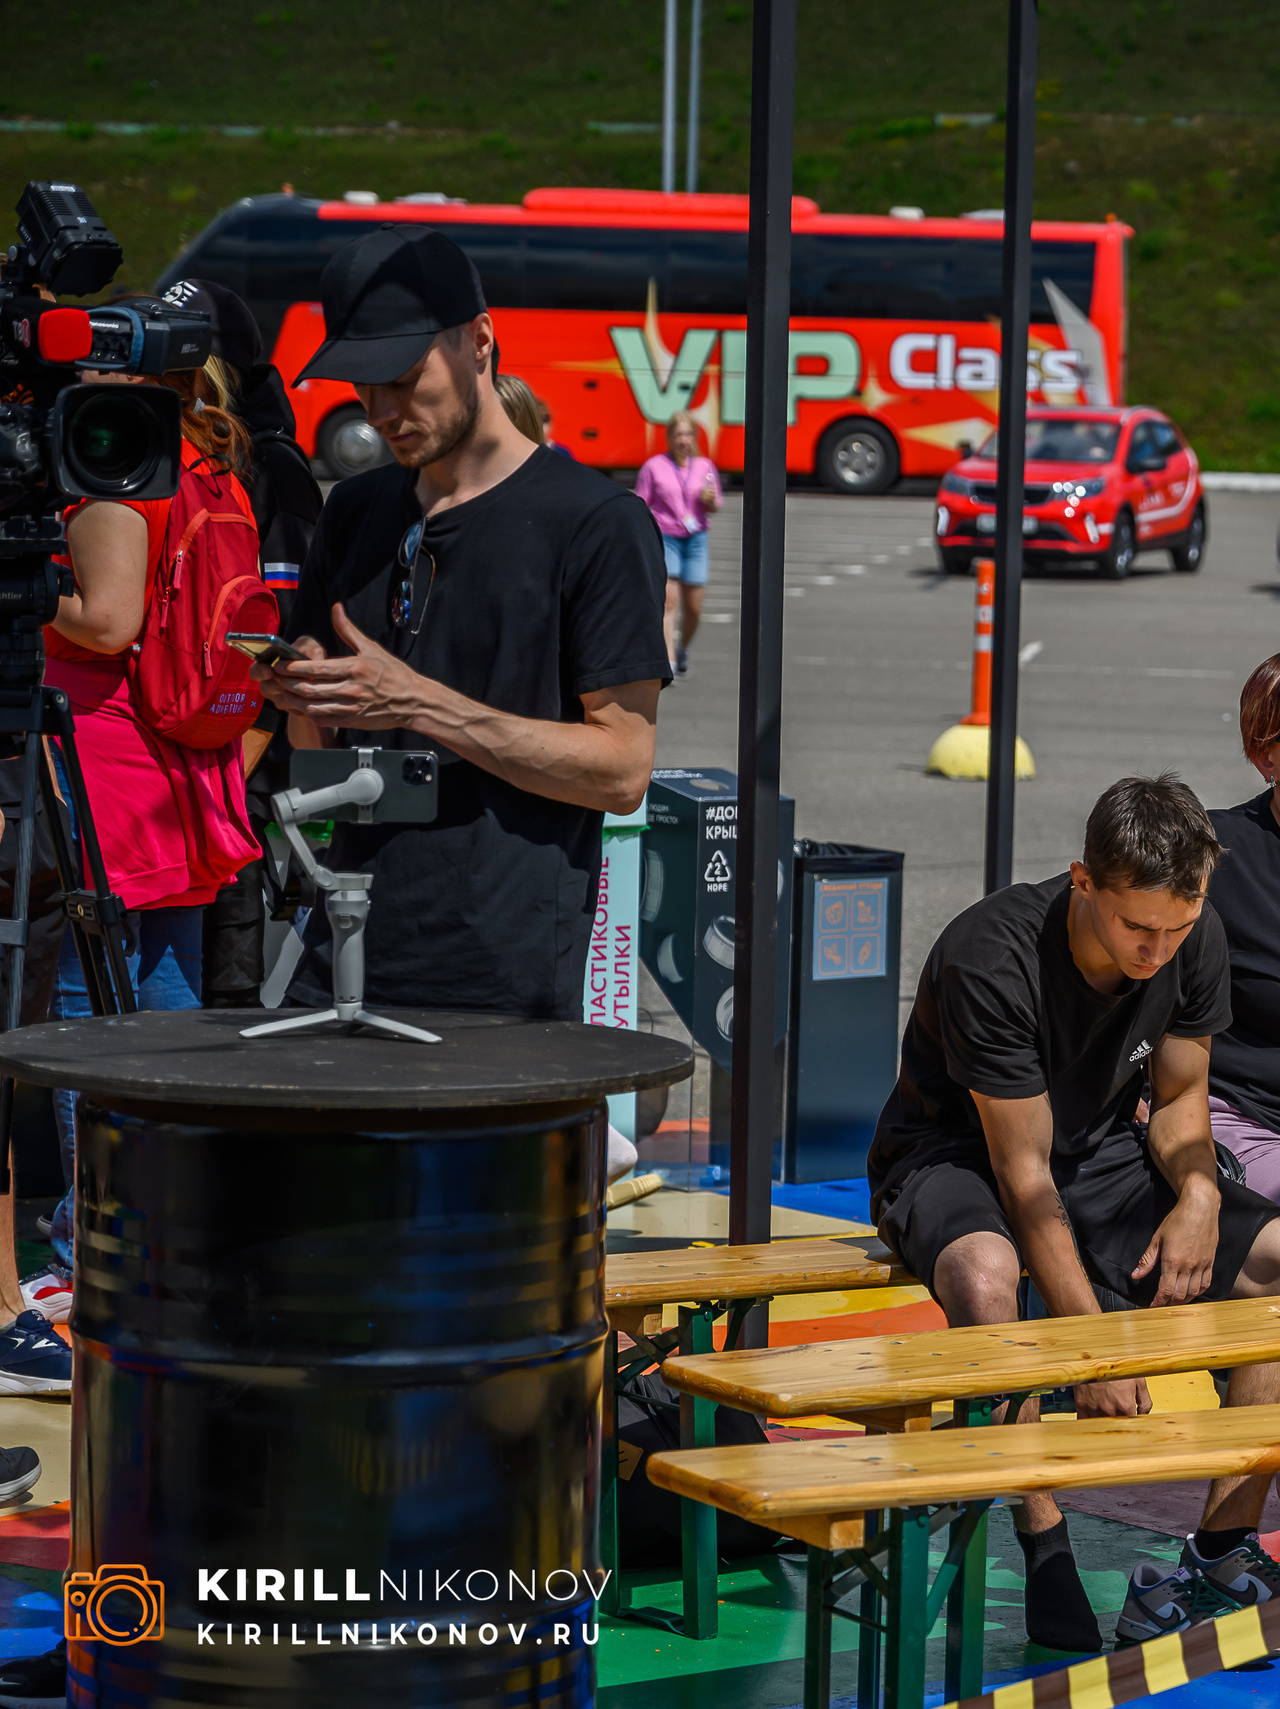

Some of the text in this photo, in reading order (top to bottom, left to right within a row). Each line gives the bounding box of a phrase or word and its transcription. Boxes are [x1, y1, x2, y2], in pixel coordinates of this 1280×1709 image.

[609, 326, 861, 425] VIP
[0, 592, 23, 600] htler
[705, 805, 738, 822] #ДО
[706, 883, 728, 892] HDPE
[590, 856, 609, 1027] ЛАСТИКОВЫЕ
[613, 925, 631, 1028] УТЫЛКИ
